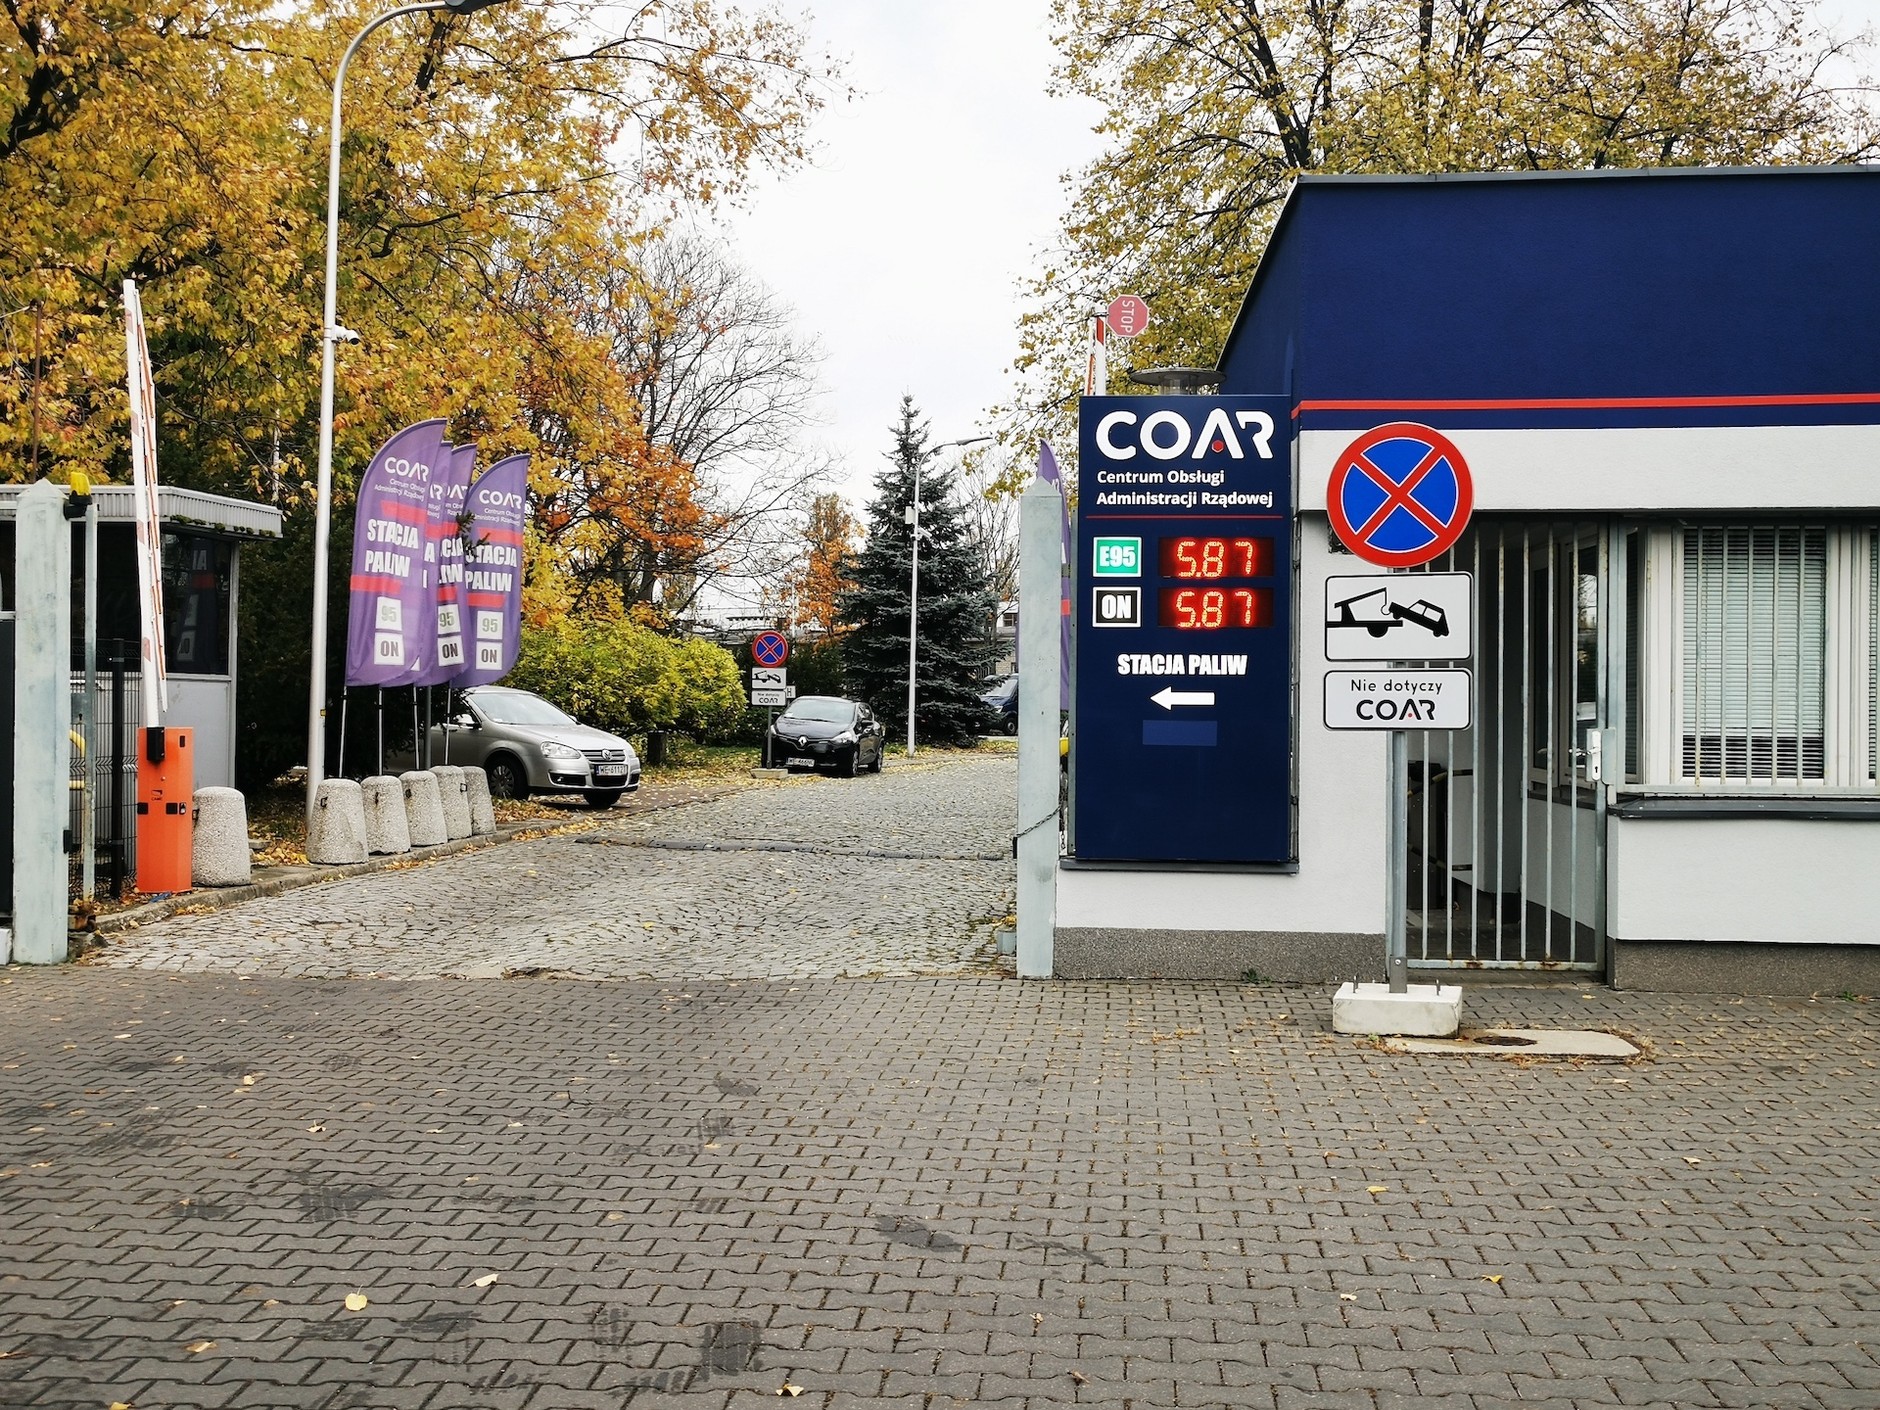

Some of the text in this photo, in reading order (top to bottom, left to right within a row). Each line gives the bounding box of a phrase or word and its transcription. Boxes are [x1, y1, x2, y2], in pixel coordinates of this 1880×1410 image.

[1120, 299, 1136, 334] STOP
[1095, 407, 1275, 461] COAR
[384, 456, 429, 482] COAR
[1097, 469, 1224, 486] Centrum Obsługi
[479, 489, 523, 509] COAR
[1096, 491, 1273, 508] Administracji Rządowej
[367, 518, 419, 549] STACJA
[365, 551, 411, 578] PALIW
[1100, 540, 1253, 577] E95 5.87
[465, 570, 513, 592] PALIW
[381, 605, 398, 622] 95
[440, 611, 454, 627] 95
[1101, 590, 1252, 627] ON 5.87
[482, 618, 499, 632] 95
[380, 640, 400, 657] ON
[442, 643, 458, 658] ON
[481, 649, 497, 662] ON
[1117, 653, 1248, 675] STACJA PALIW
[1351, 679, 1442, 695] Nie dotyczy
[1356, 698, 1436, 720] COAR
